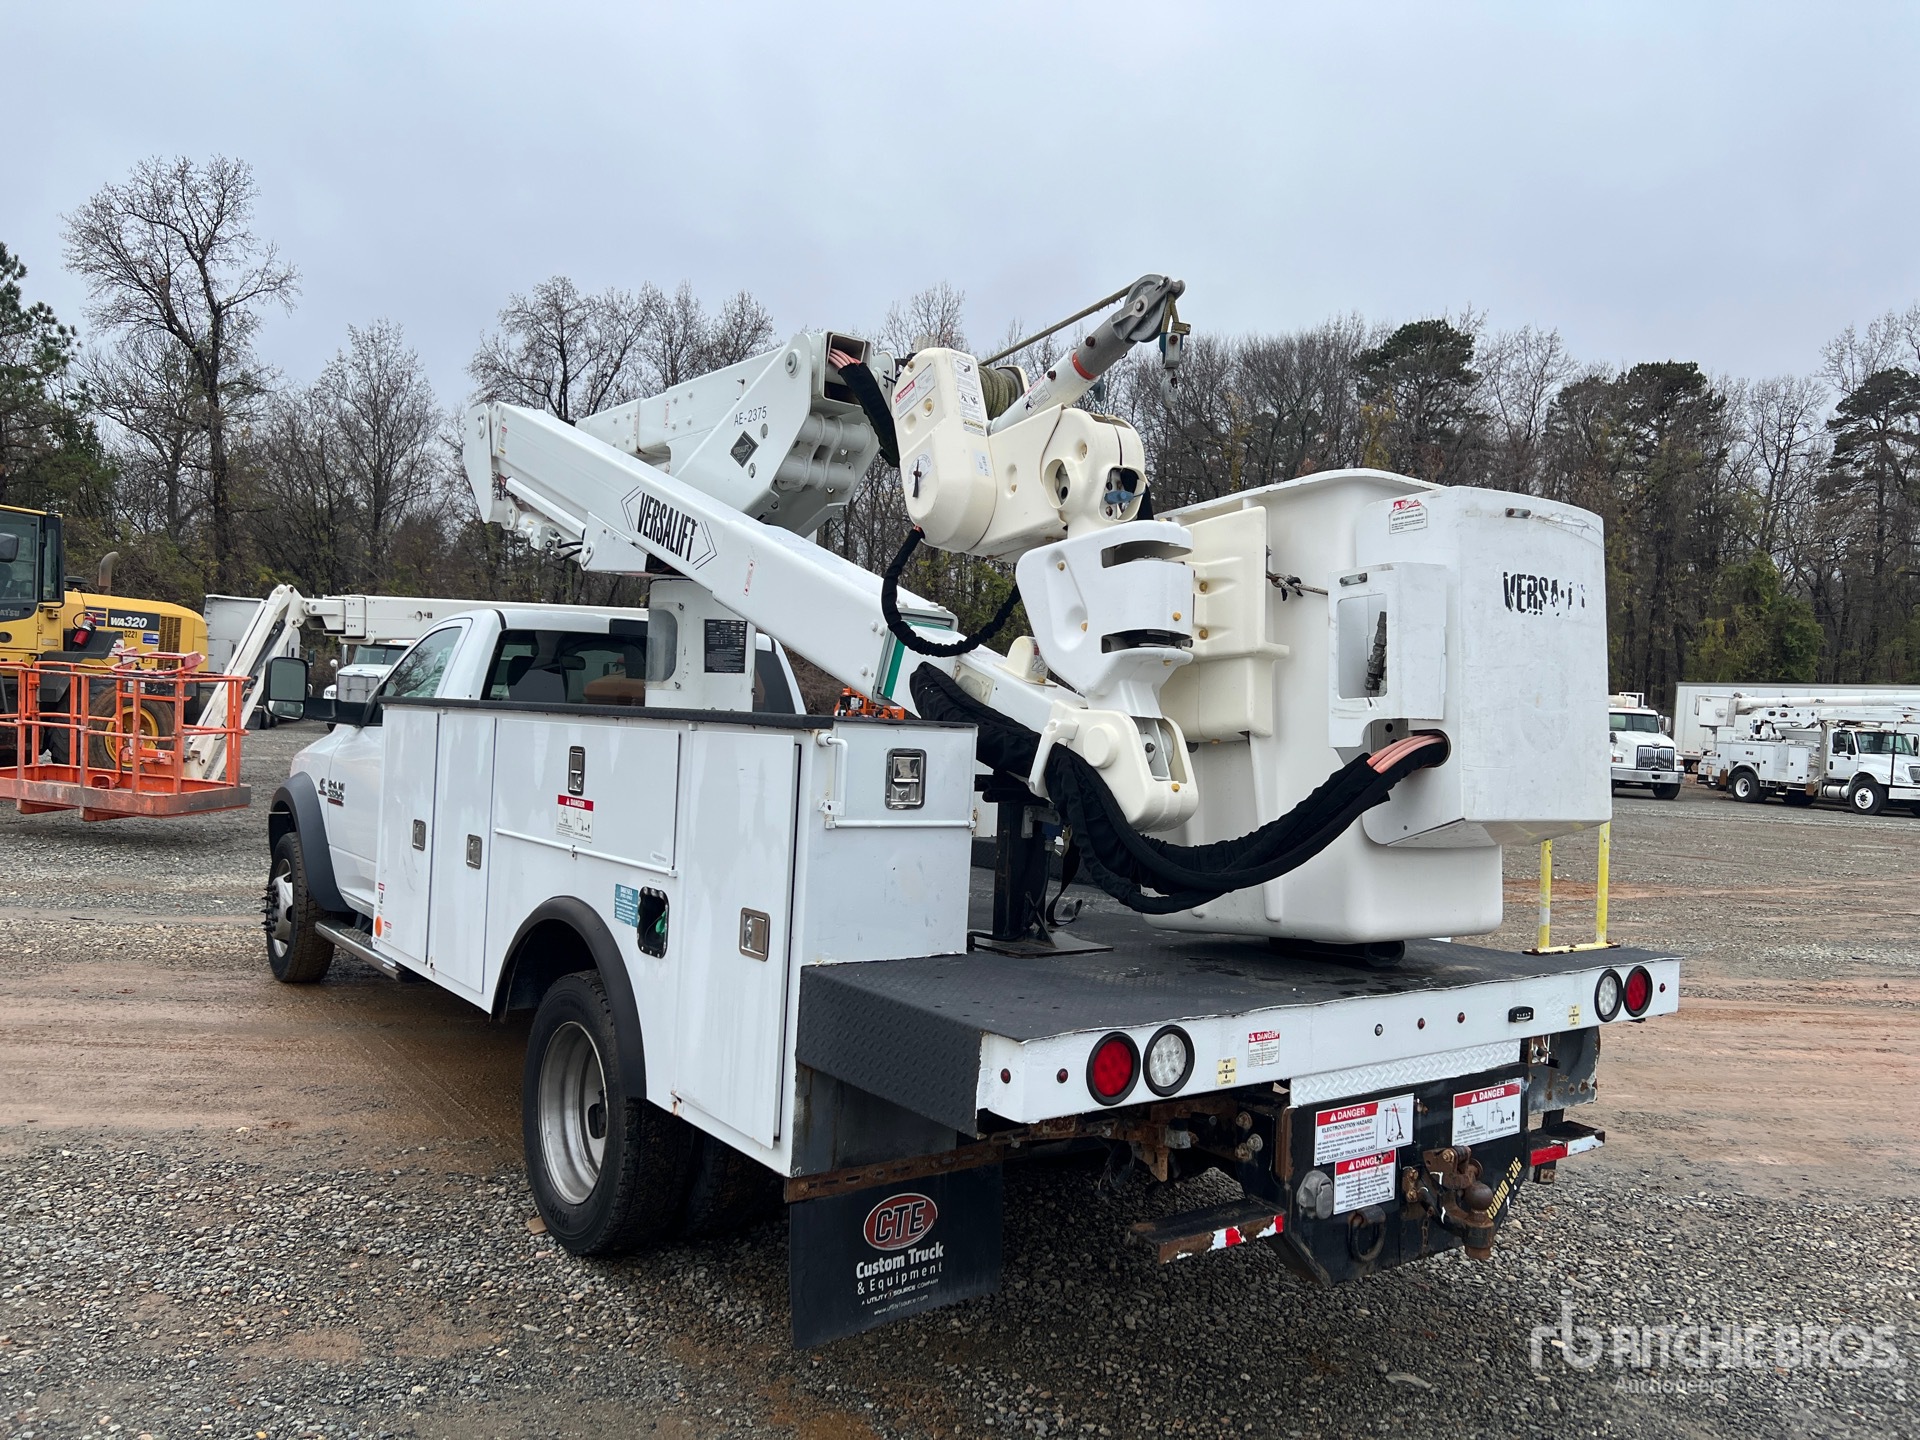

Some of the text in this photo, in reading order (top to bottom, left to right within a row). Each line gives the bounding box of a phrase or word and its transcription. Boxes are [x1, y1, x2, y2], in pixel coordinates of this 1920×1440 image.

[734, 406, 767, 427] AE-2375
[637, 492, 698, 562] VERSALIFT
[110, 616, 148, 629] WA320
[1479, 1087, 1505, 1101] DANGER
[1337, 1107, 1366, 1120] DANGER
[874, 1200, 926, 1243] CTE
[856, 1241, 944, 1279] Custom Truck
[857, 1262, 943, 1296] & Equipment
